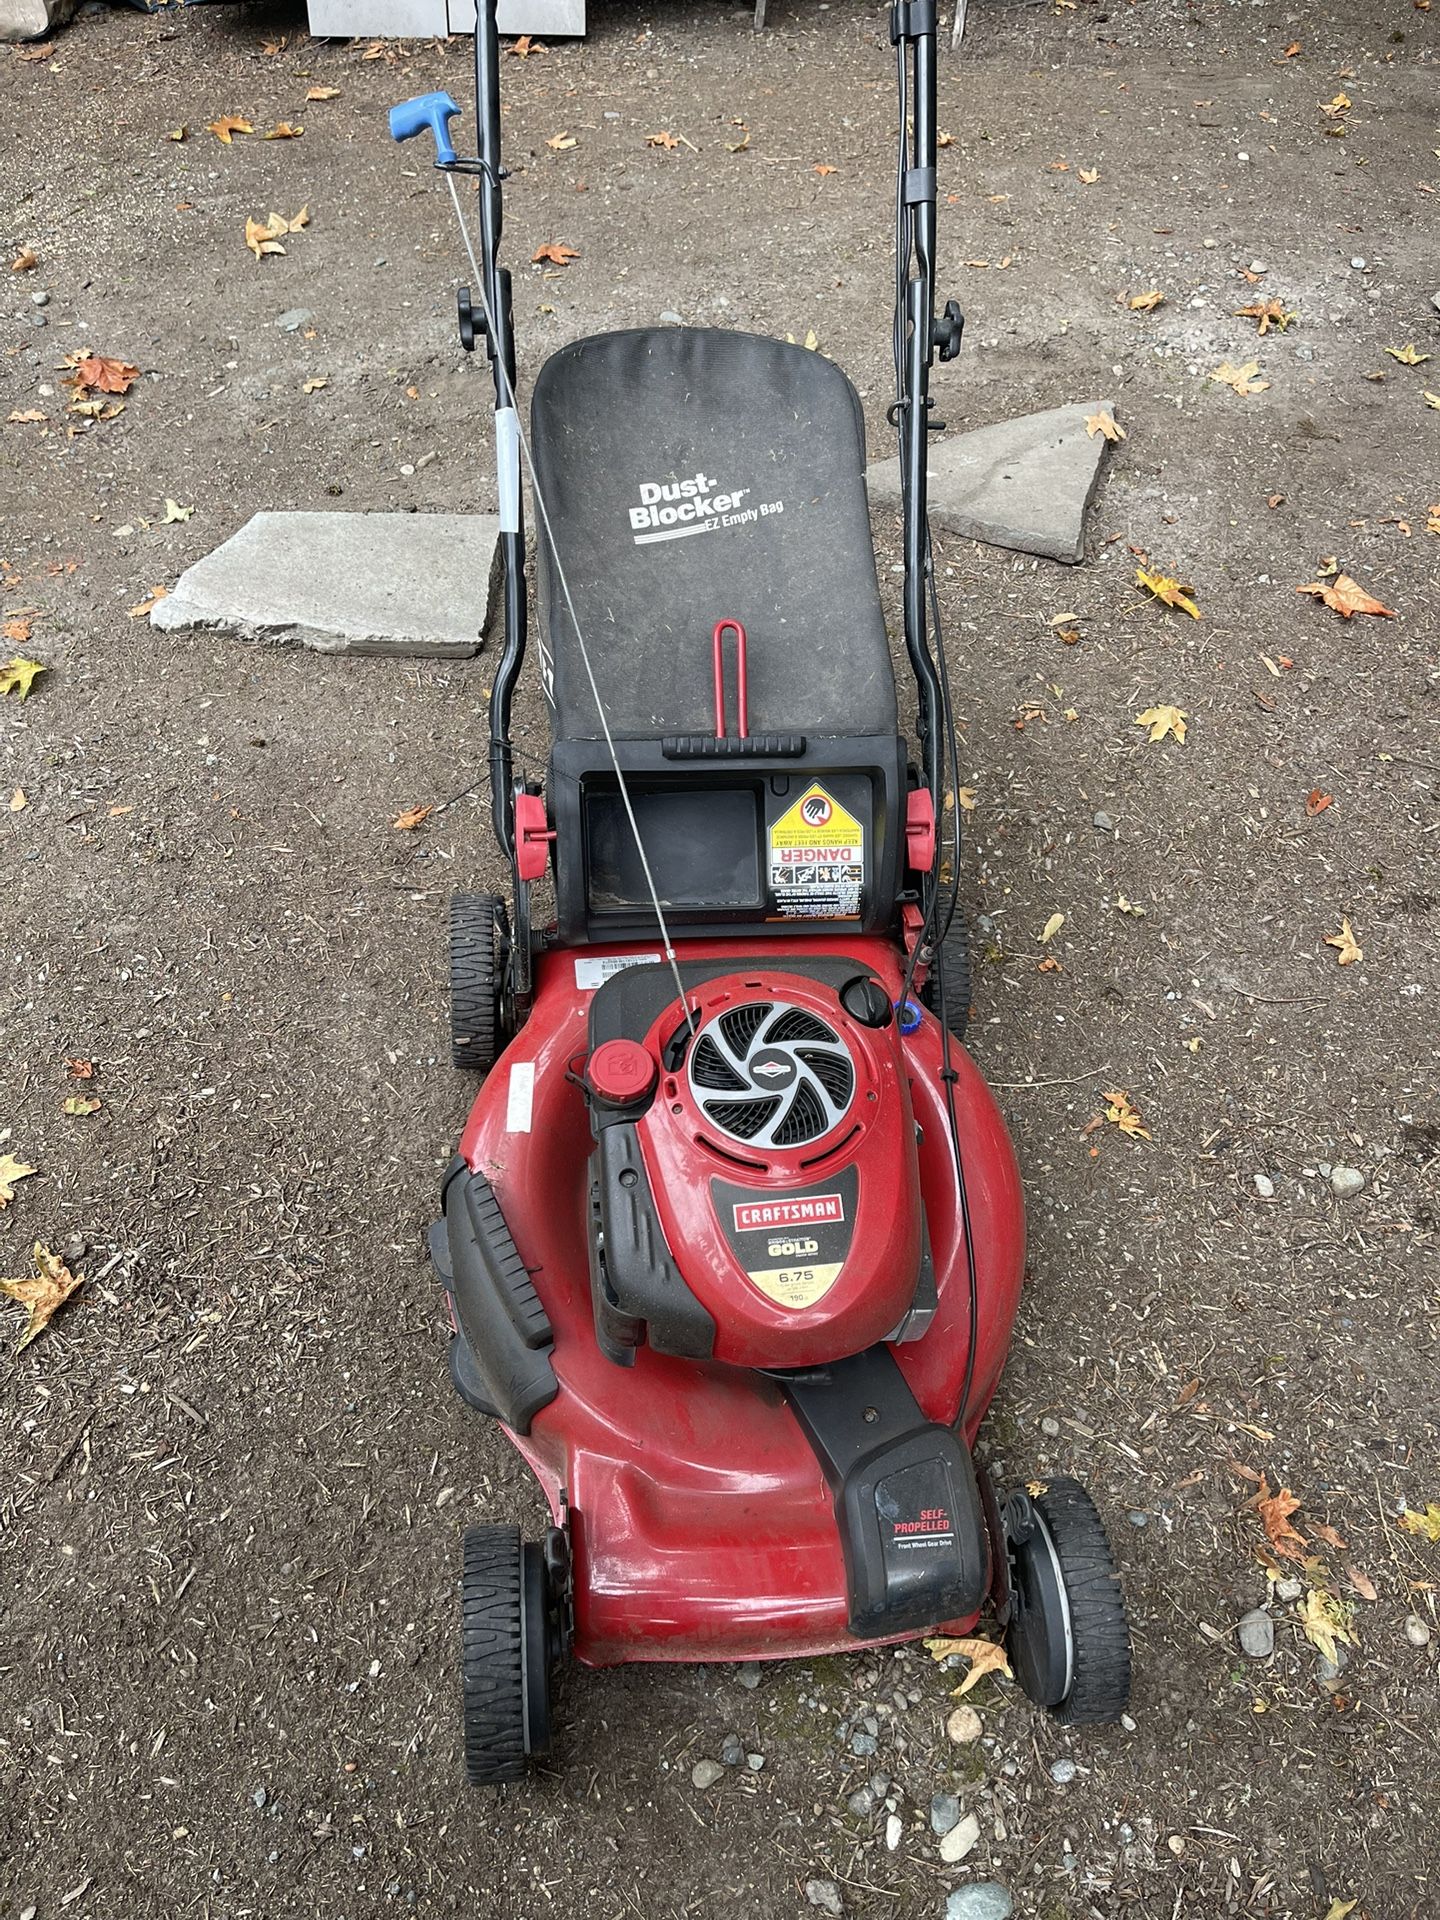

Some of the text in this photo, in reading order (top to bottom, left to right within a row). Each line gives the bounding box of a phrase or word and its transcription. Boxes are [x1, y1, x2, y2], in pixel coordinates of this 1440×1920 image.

[639, 473, 718, 505] Dust-
[705, 501, 784, 531] EZ Empty Bag
[781, 848, 852, 862] DANGER
[742, 1201, 837, 1224] CRAFTSMAN
[768, 1240, 819, 1257] GOLD
[779, 1271, 814, 1283] 6.75
[920, 1509, 948, 1520] SELF-
[894, 1520, 950, 1533] PROPELLED
[912, 1541, 927, 1549] Wheel
